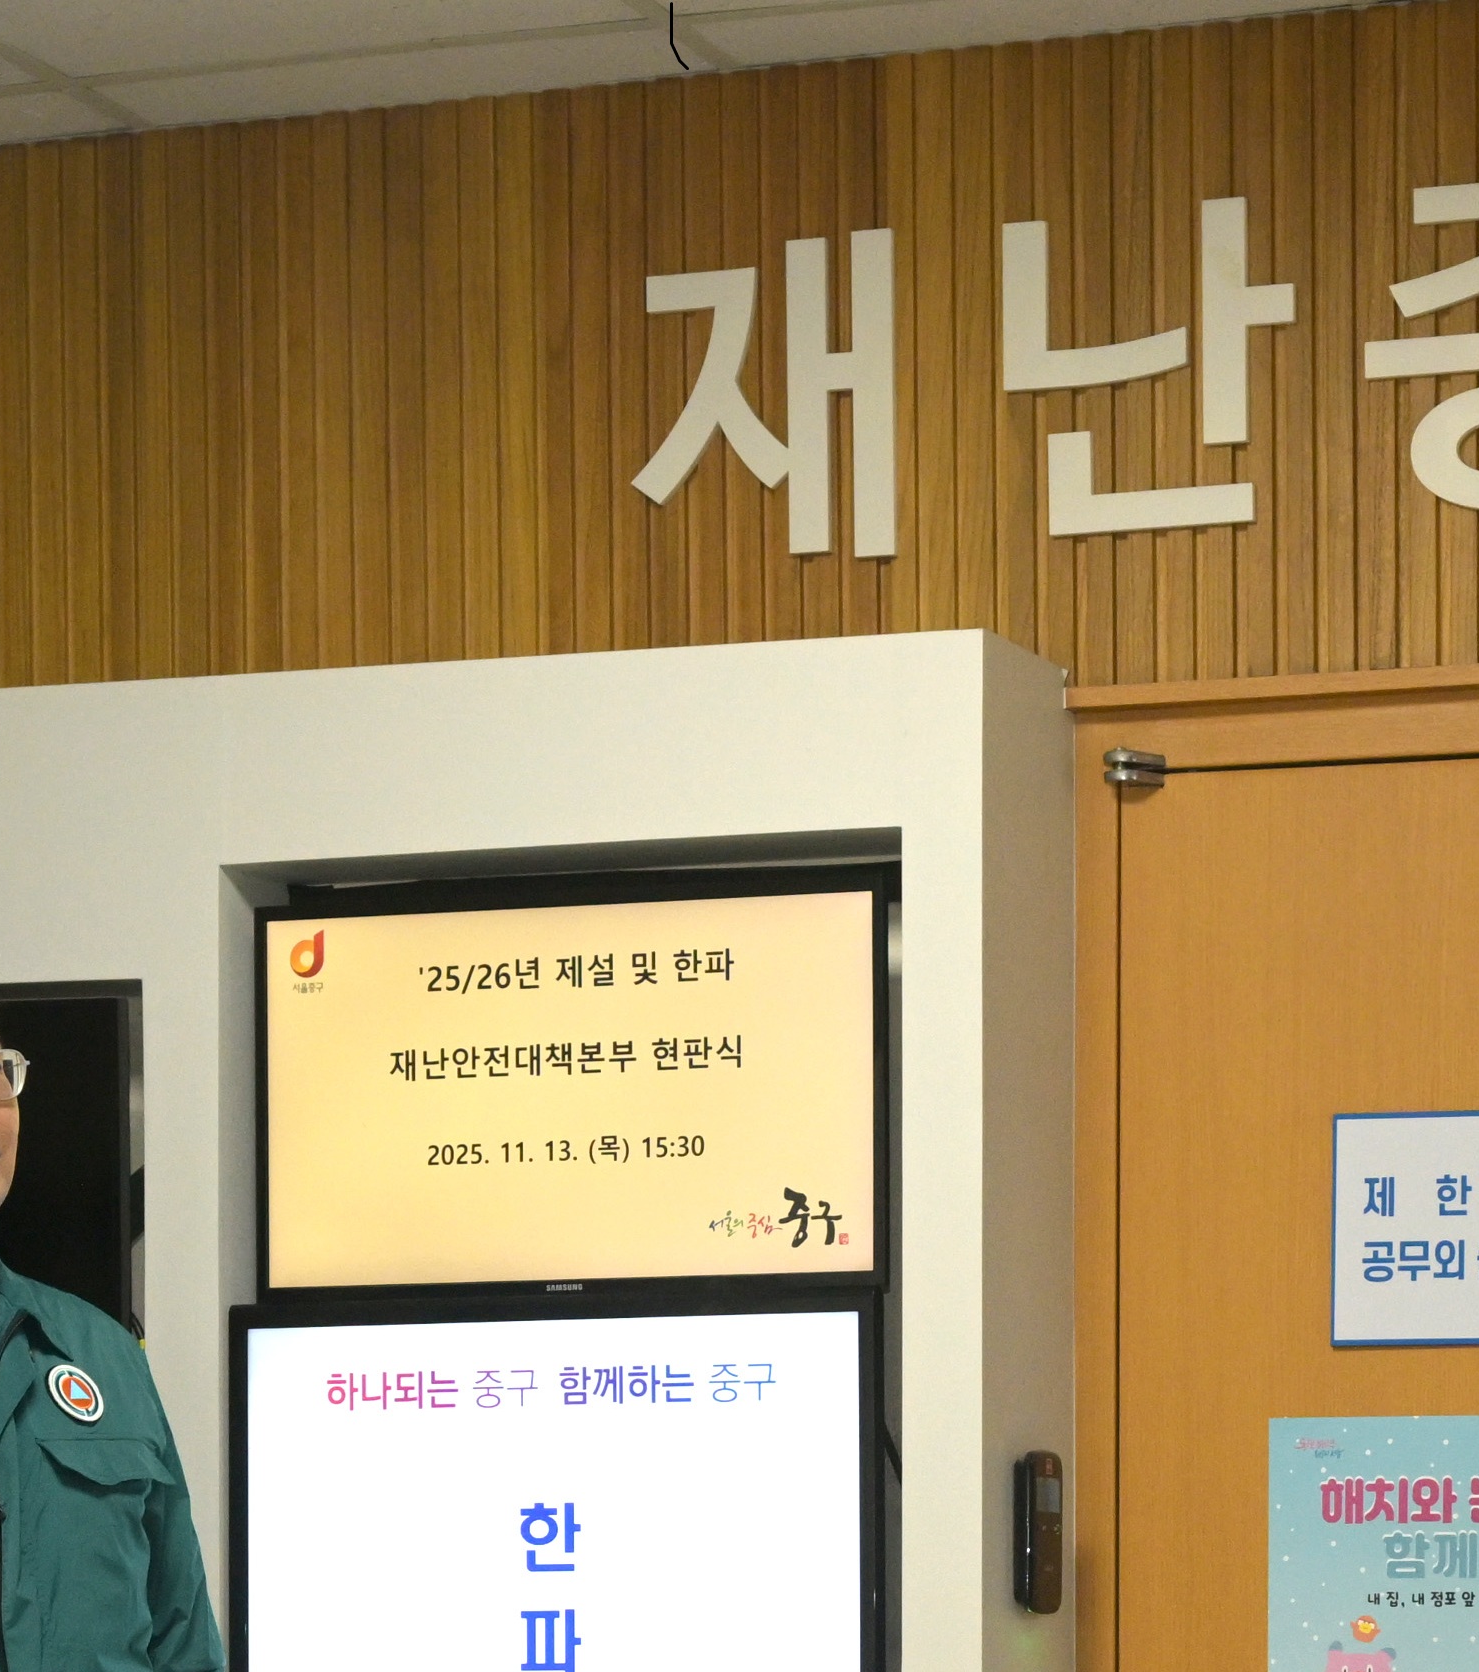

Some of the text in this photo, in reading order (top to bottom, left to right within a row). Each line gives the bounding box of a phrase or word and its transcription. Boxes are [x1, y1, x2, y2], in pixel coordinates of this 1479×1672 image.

[419, 948, 735, 994] '25/26년 제설 및 한파
[389, 1035, 742, 1082] 재난안전대책본부 현판식
[427, 1135, 705, 1166] 2025. 11. 13. (목) 15:30
[778, 1186, 842, 1248] 중구
[1362, 1239, 1465, 1282] 공무외
[545, 1283, 583, 1291] SAMSUNG
[326, 1362, 777, 1411] 하나되는 중구 함께하는 중구
[1319, 1475, 1458, 1524] 해치와
[1368, 1592, 1381, 1606] 내
[1386, 1591, 1405, 1608] 집,
[1411, 1592, 1426, 1606] 내
[1430, 1591, 1457, 1607] 점포
[1461, 1591, 1476, 1607] 앞
